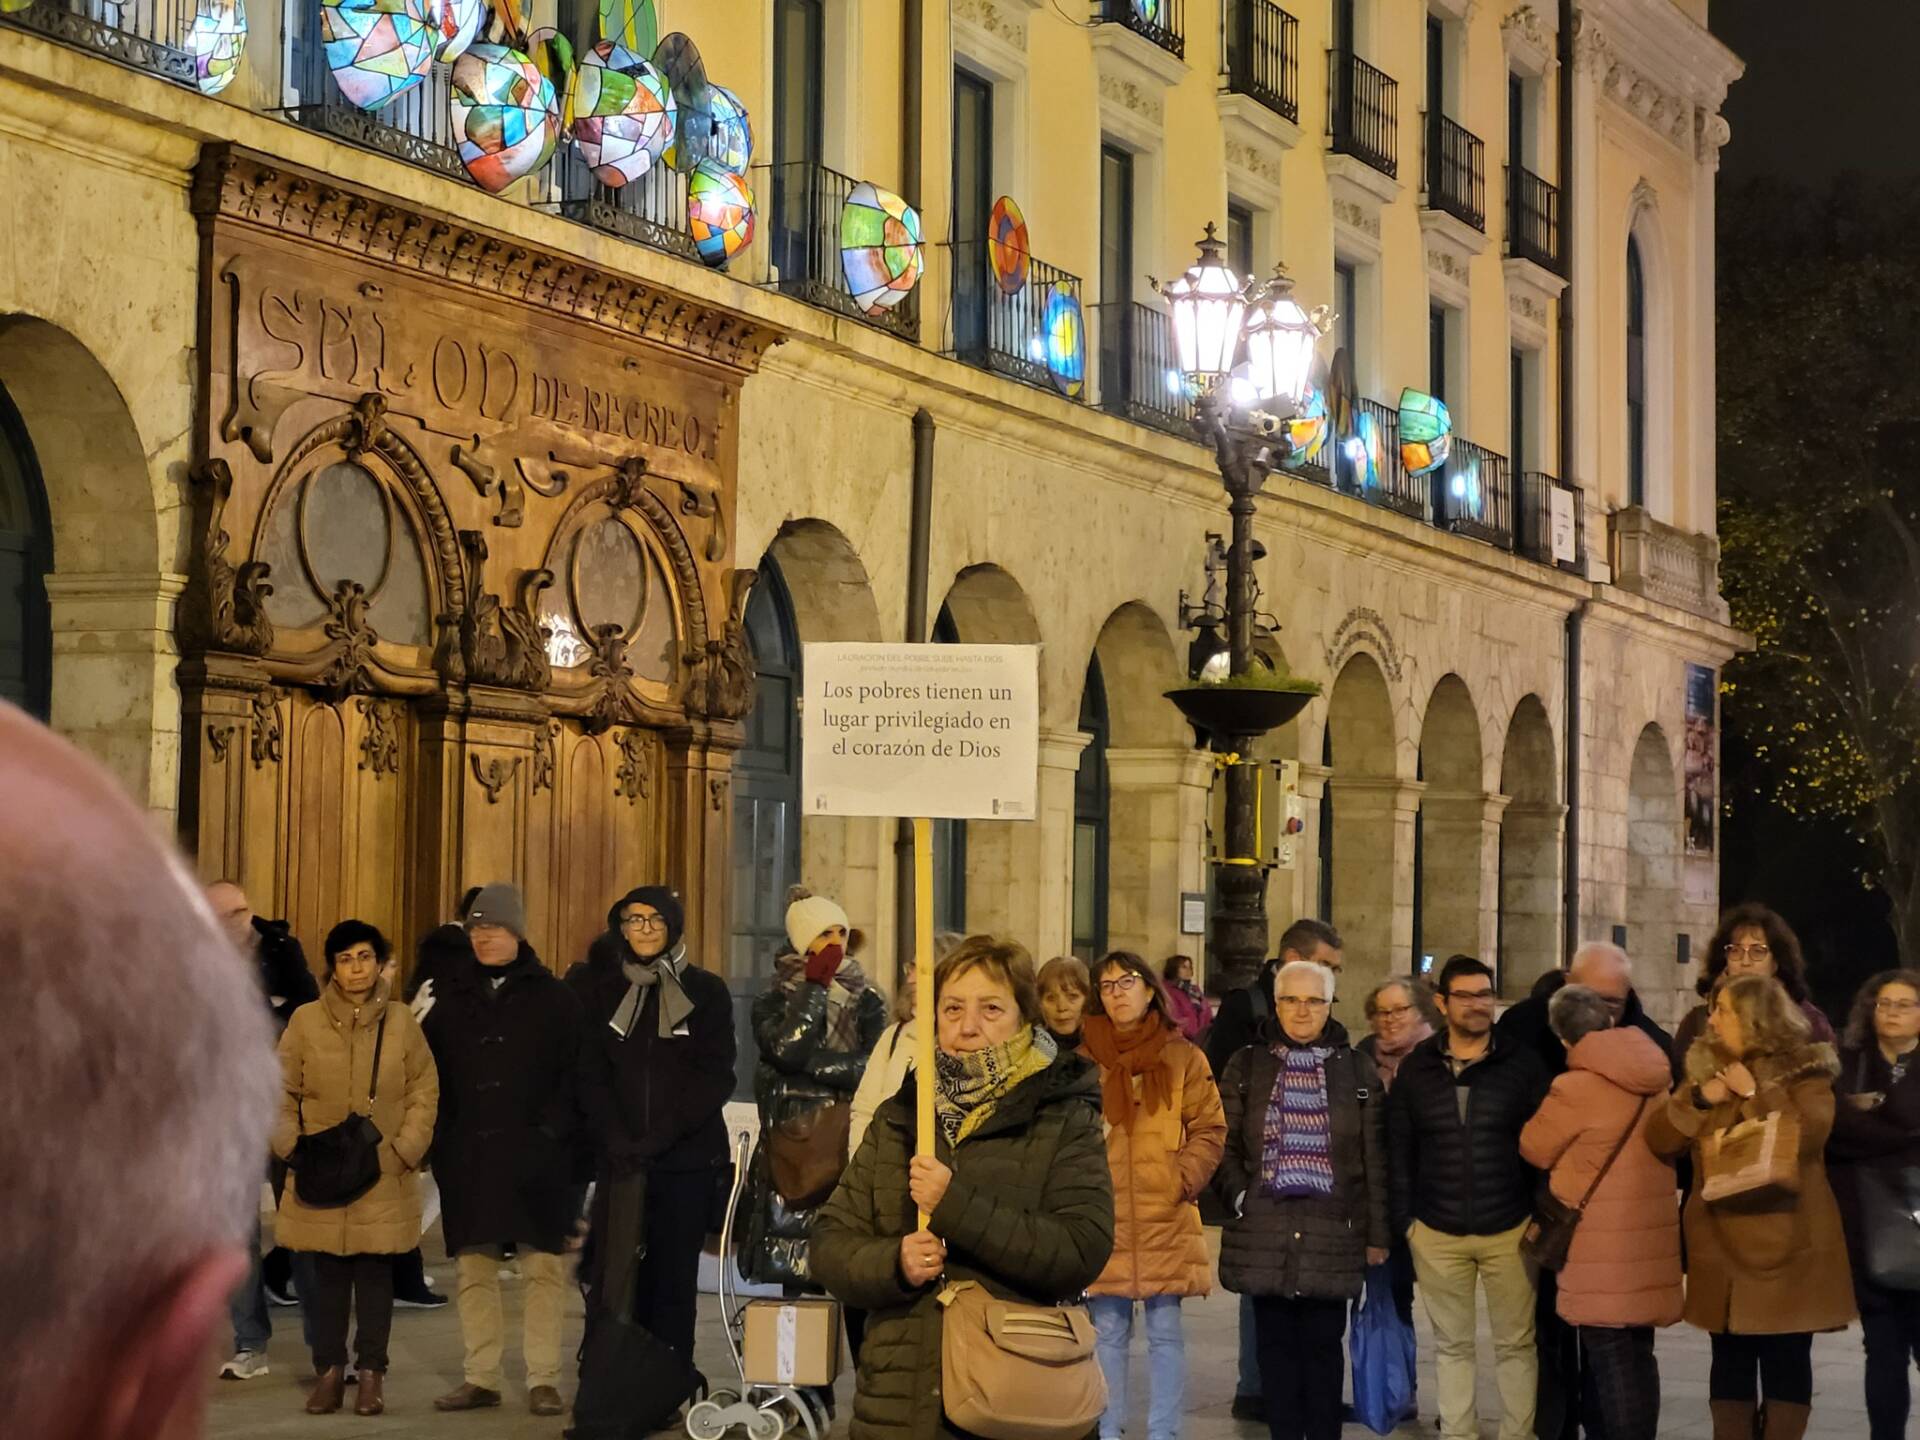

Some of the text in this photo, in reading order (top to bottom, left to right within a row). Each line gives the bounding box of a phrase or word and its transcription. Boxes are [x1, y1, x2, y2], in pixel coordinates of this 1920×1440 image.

[531, 372, 577, 425] DE
[823, 680, 1012, 704] Los pobres tienen un
[823, 708, 1011, 734] lugar privilegiado en
[832, 737, 1001, 758] el corazón de Dios
